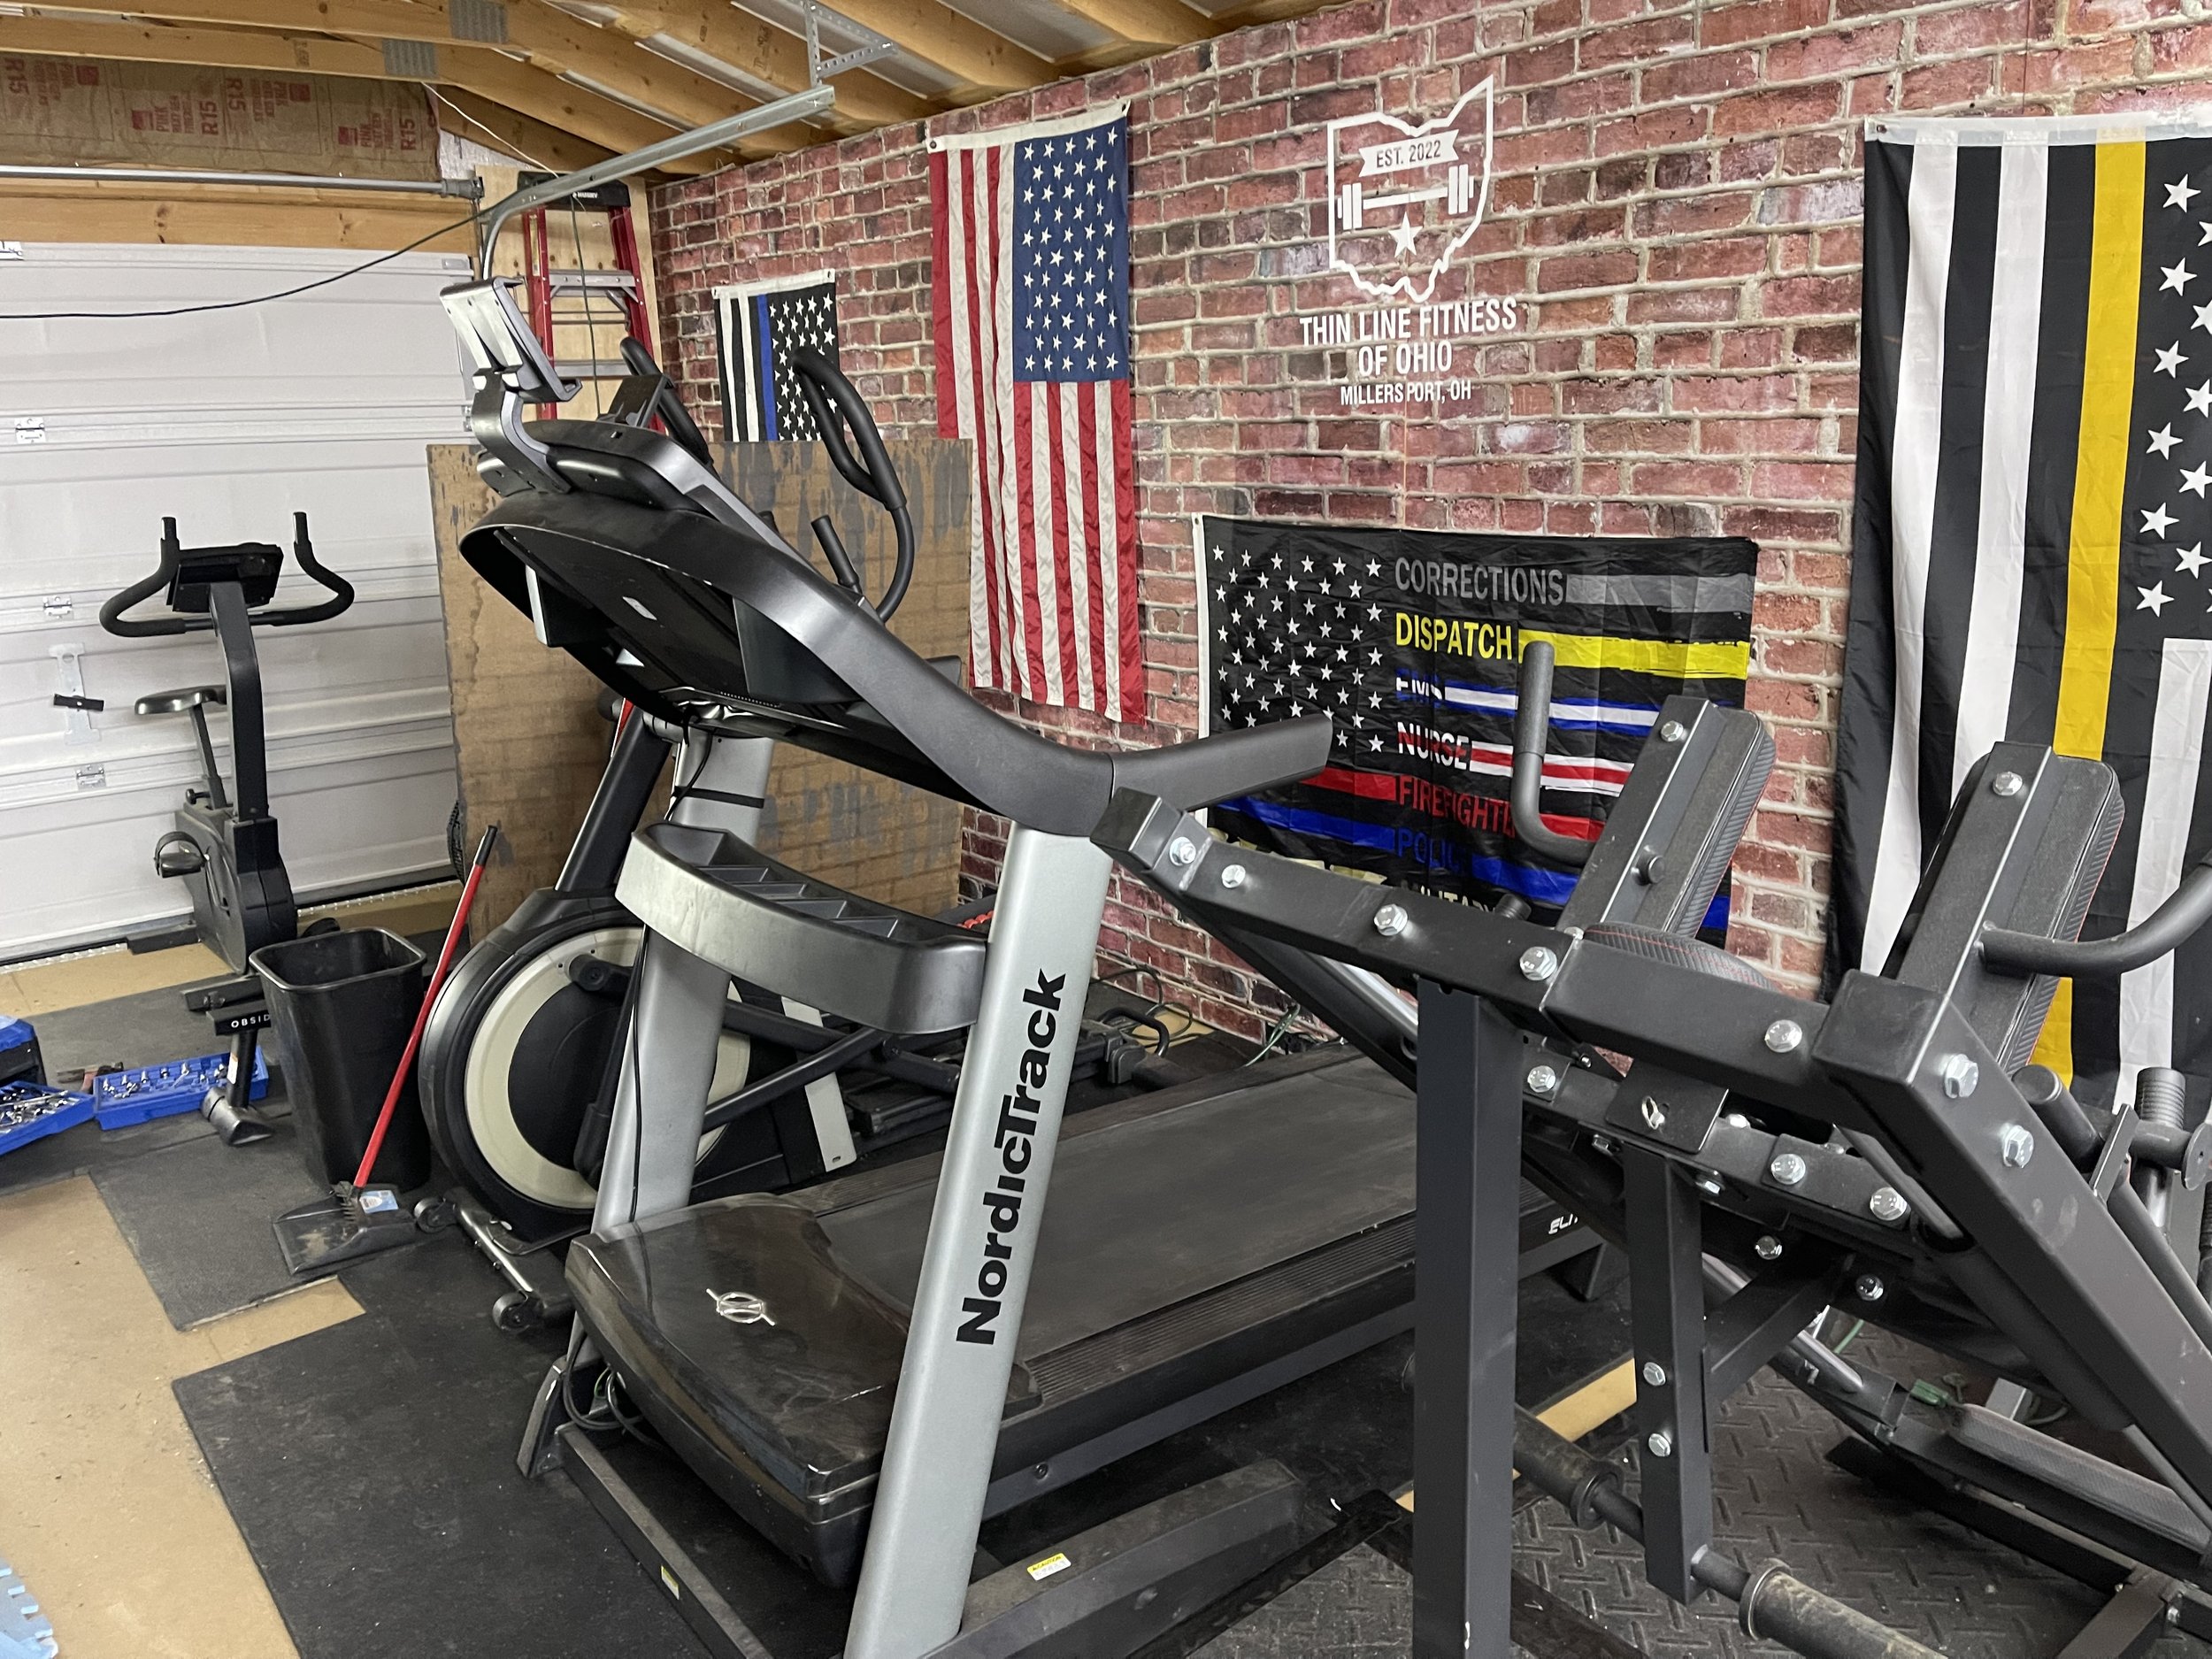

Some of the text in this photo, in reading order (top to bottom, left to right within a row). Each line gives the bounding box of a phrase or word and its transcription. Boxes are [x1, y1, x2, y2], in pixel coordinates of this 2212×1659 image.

[226, 78, 246, 111] R15
[199, 101, 219, 134] R15
[399, 118, 416, 150] R15
[1376, 140, 1440, 168] EST. 2022
[1300, 296, 1517, 346] THIN LINE FITNESS
[1358, 340, 1452, 376] OF OHIO
[1450, 380, 1471, 400] OH
[1395, 557, 1563, 606] CORRECTIONS
[1395, 612, 1512, 660] DISPATCH
[1395, 668, 1443, 708] EMS
[1397, 721, 1470, 771] NURSE
[1399, 774, 1515, 839] FIREFIGHTE
[956, 968, 1066, 1345] NordicTrack
